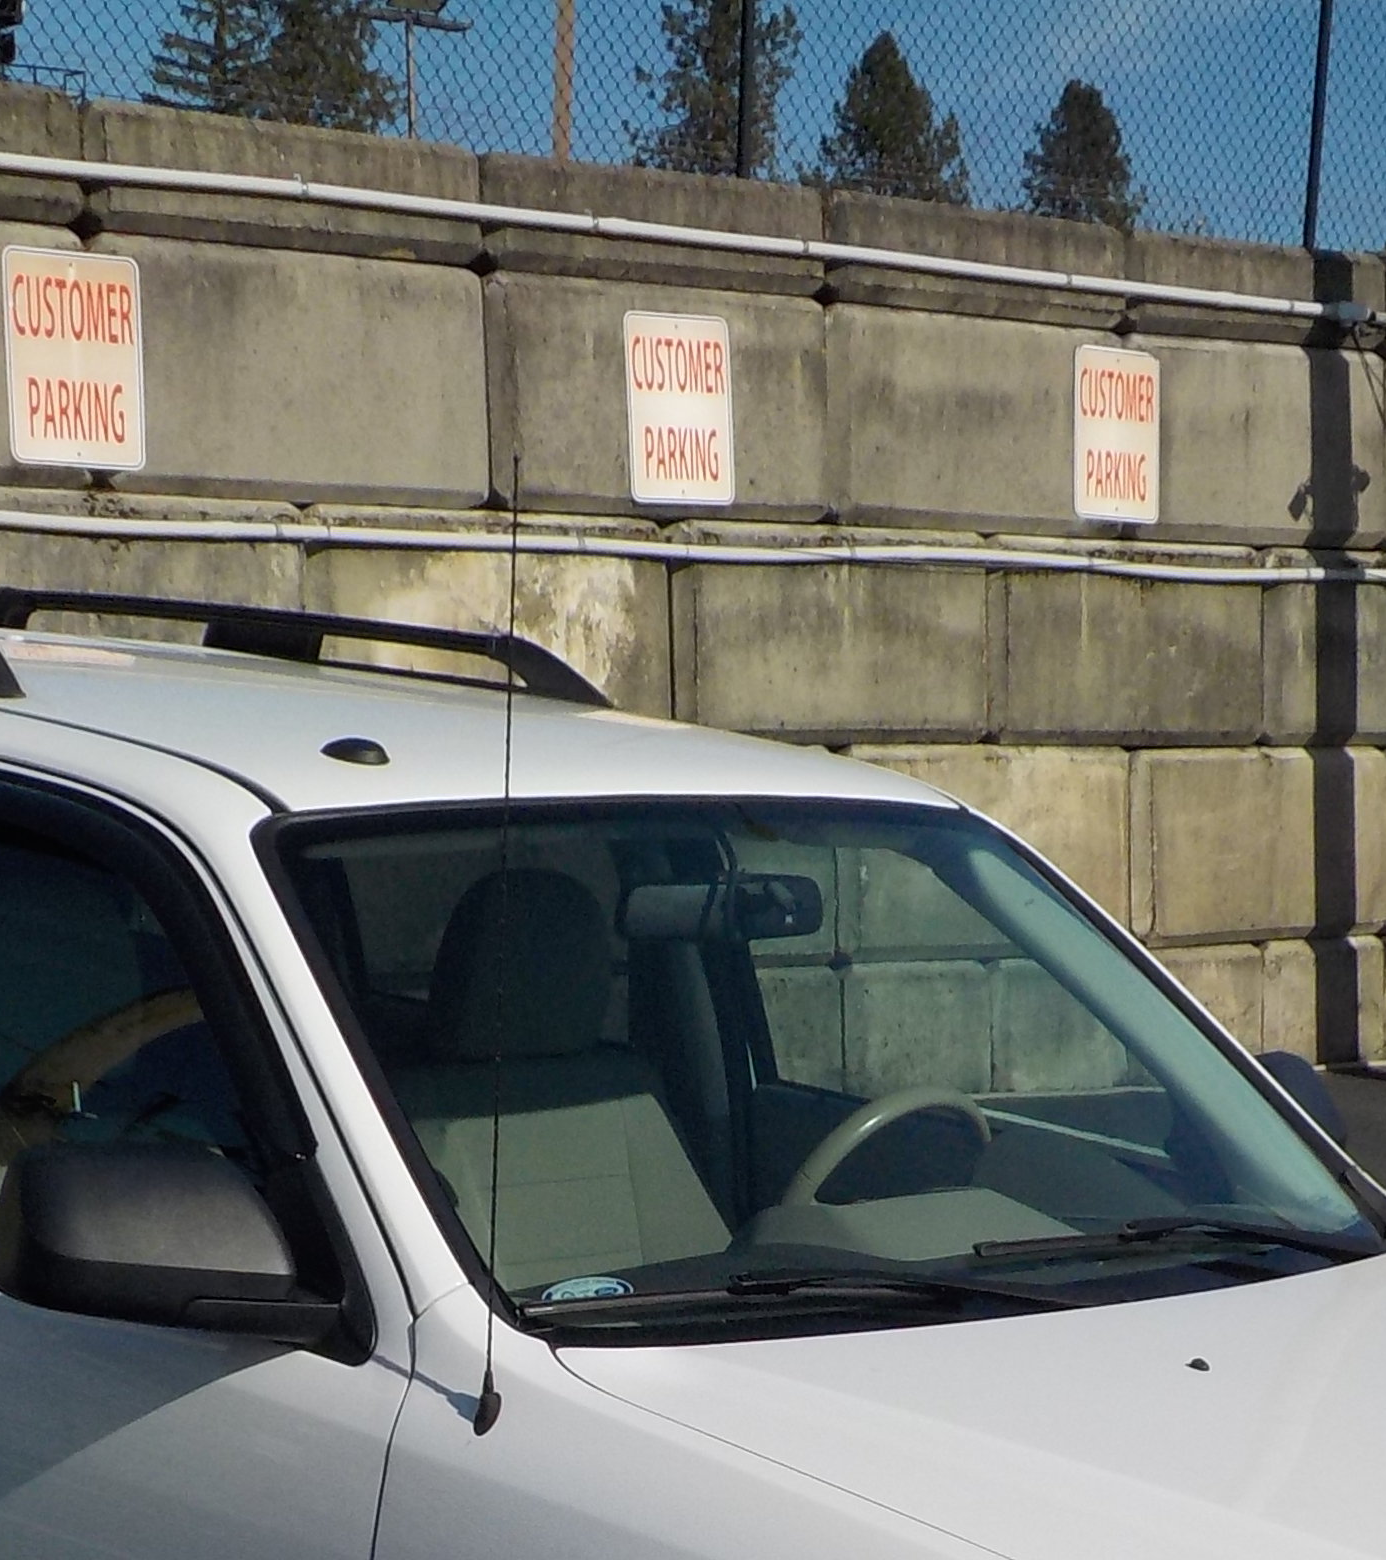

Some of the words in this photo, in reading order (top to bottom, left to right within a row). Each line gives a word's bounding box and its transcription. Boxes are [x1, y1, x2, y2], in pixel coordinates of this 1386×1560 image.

[11, 273, 134, 346] CUSTOMER
[631, 335, 726, 395] CUSTOMER
[27, 376, 126, 444] PARKING
[1079, 367, 1155, 423] CUSTOMER
[644, 425, 719, 482] PARKING
[1085, 448, 1148, 502] PARKING
